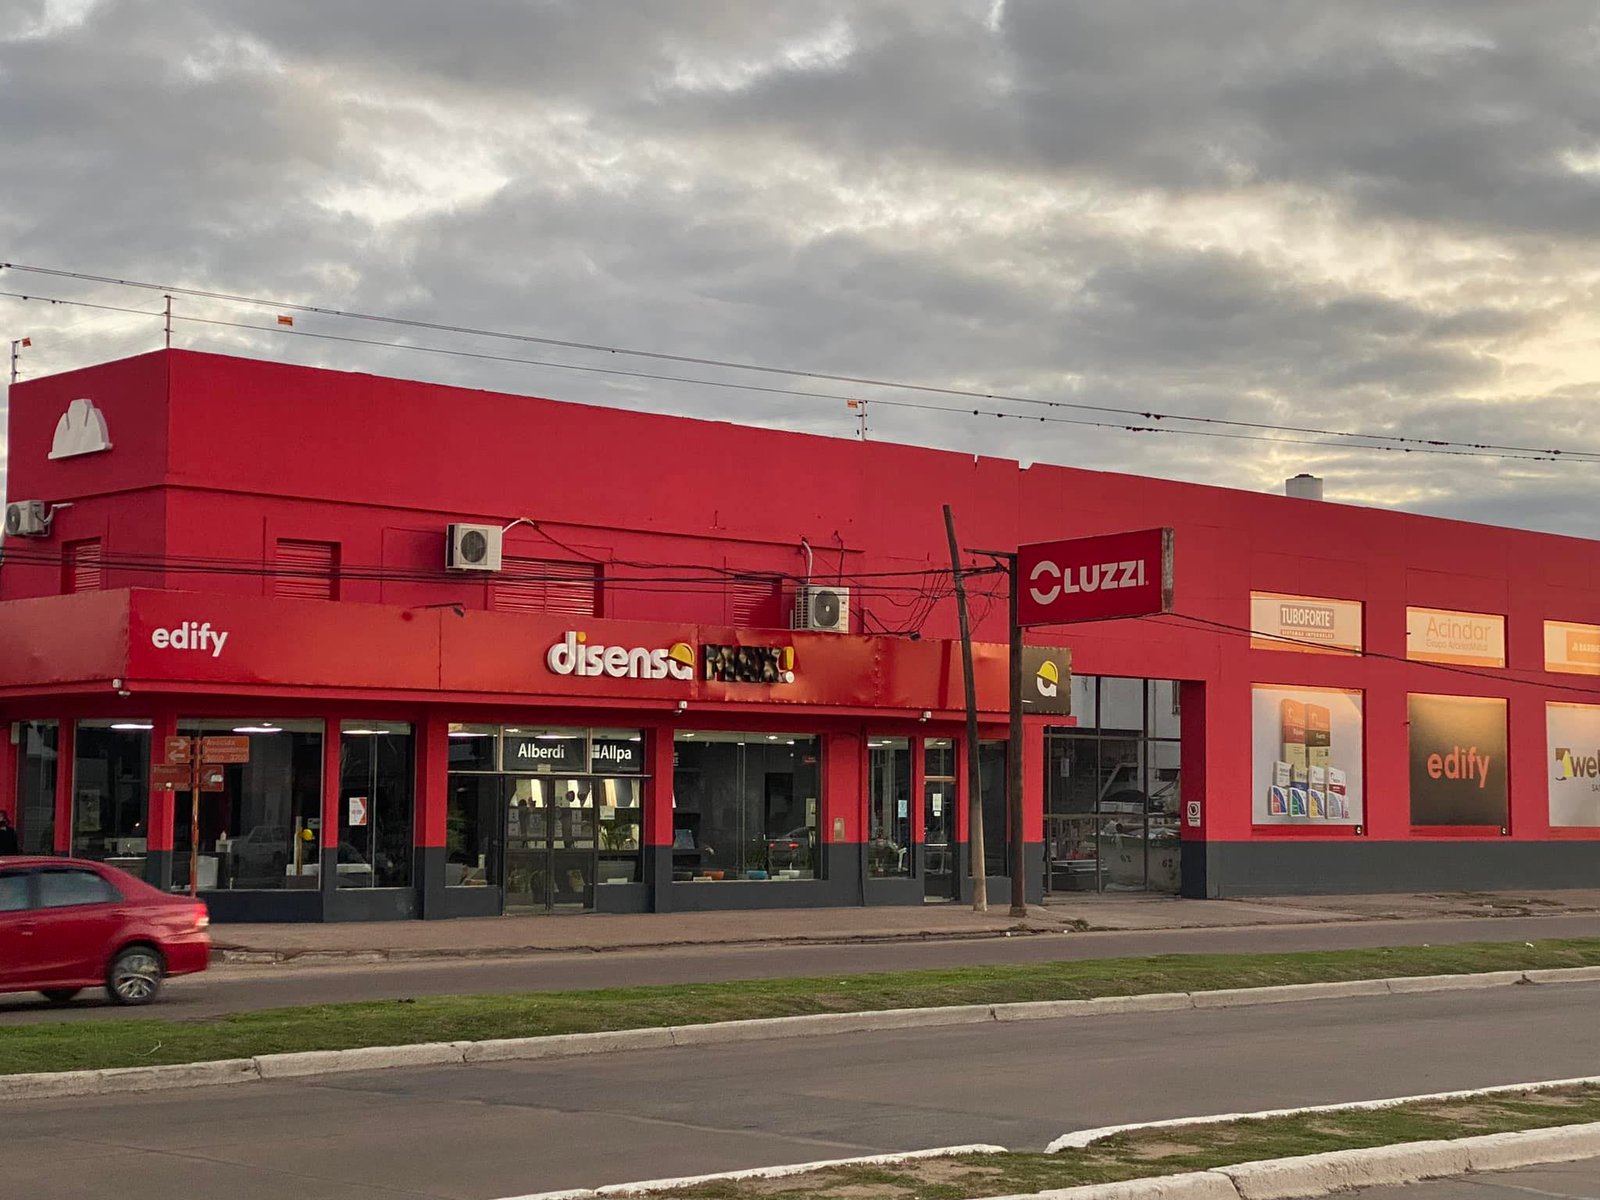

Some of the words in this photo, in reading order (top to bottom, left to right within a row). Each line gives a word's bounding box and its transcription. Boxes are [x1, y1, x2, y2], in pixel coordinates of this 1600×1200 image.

[1281, 607, 1331, 627] TUBOFORTE
[1425, 615, 1491, 642] Acindar
[152, 621, 229, 658] edify
[547, 630, 695, 681] disensa
[517, 742, 565, 759] Alberdi
[600, 744, 632, 763] Allpa
[1427, 745, 1491, 789] edify
